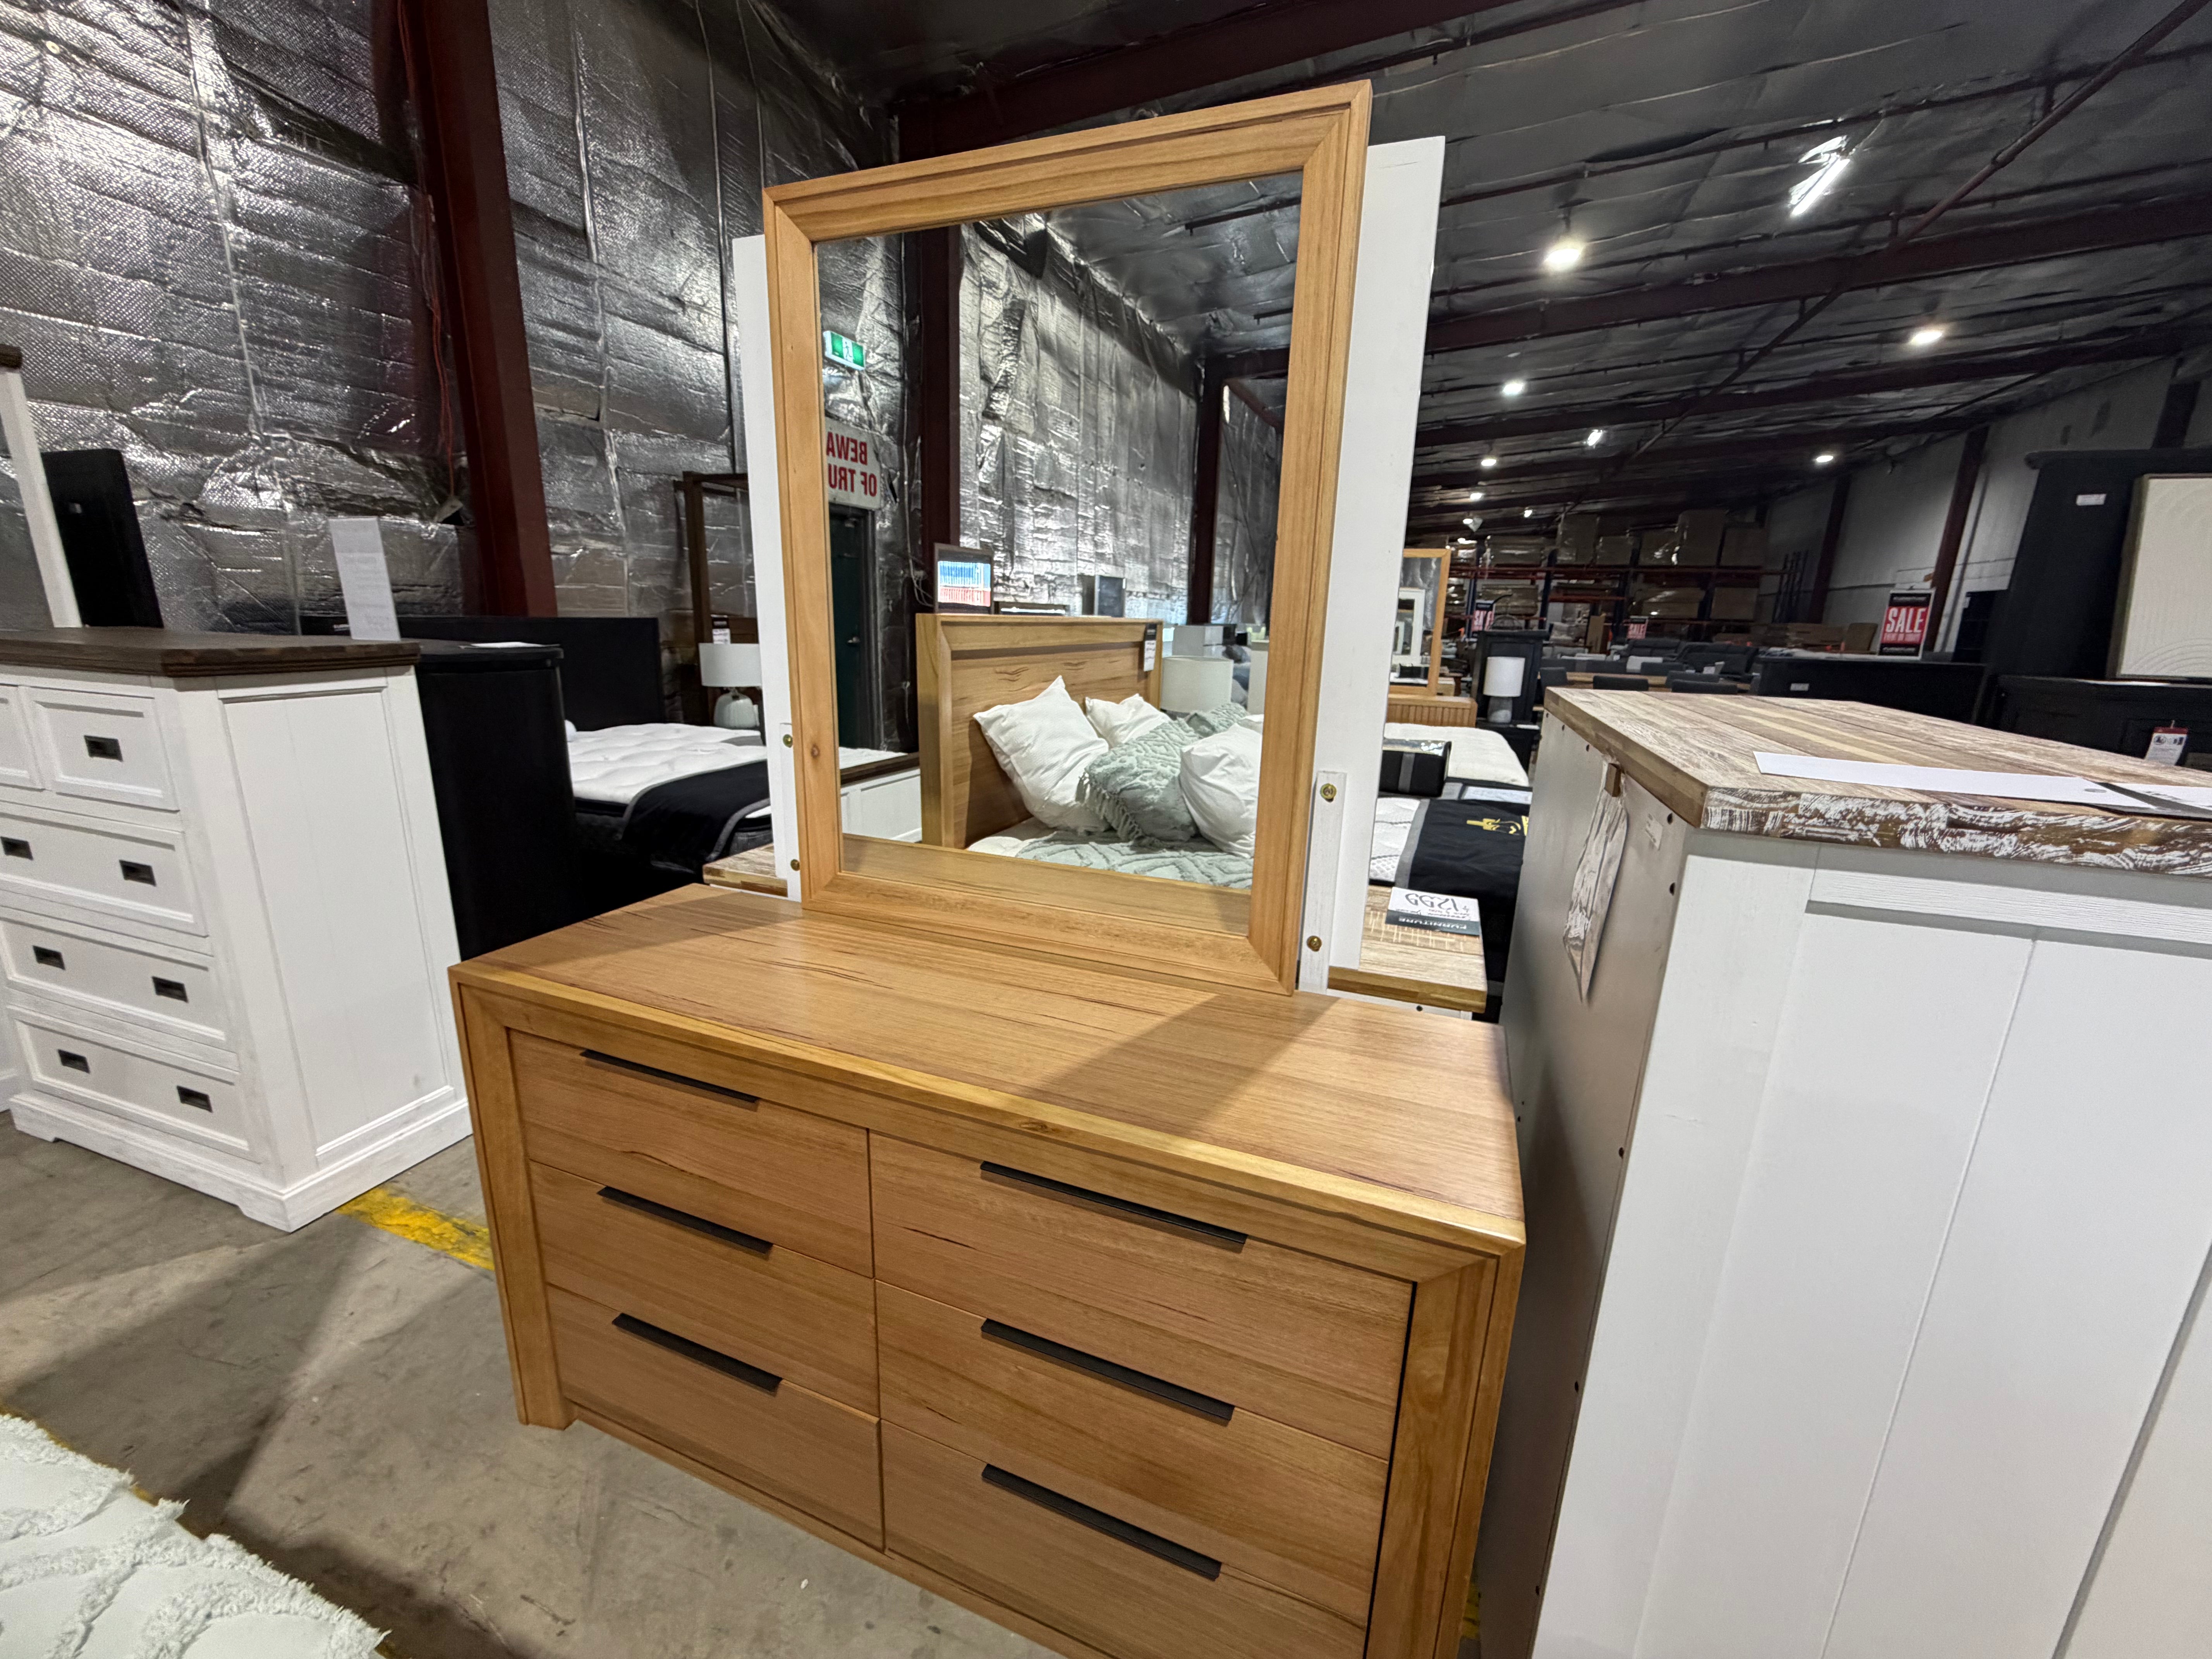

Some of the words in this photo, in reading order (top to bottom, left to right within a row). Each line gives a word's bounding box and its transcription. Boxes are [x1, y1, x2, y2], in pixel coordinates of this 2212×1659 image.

[1474, 610, 1494, 625] SAE
[1886, 608, 1926, 632] SALE
[1628, 624, 1645, 635] SALE
[1398, 917, 1467, 929] FURNITURE
